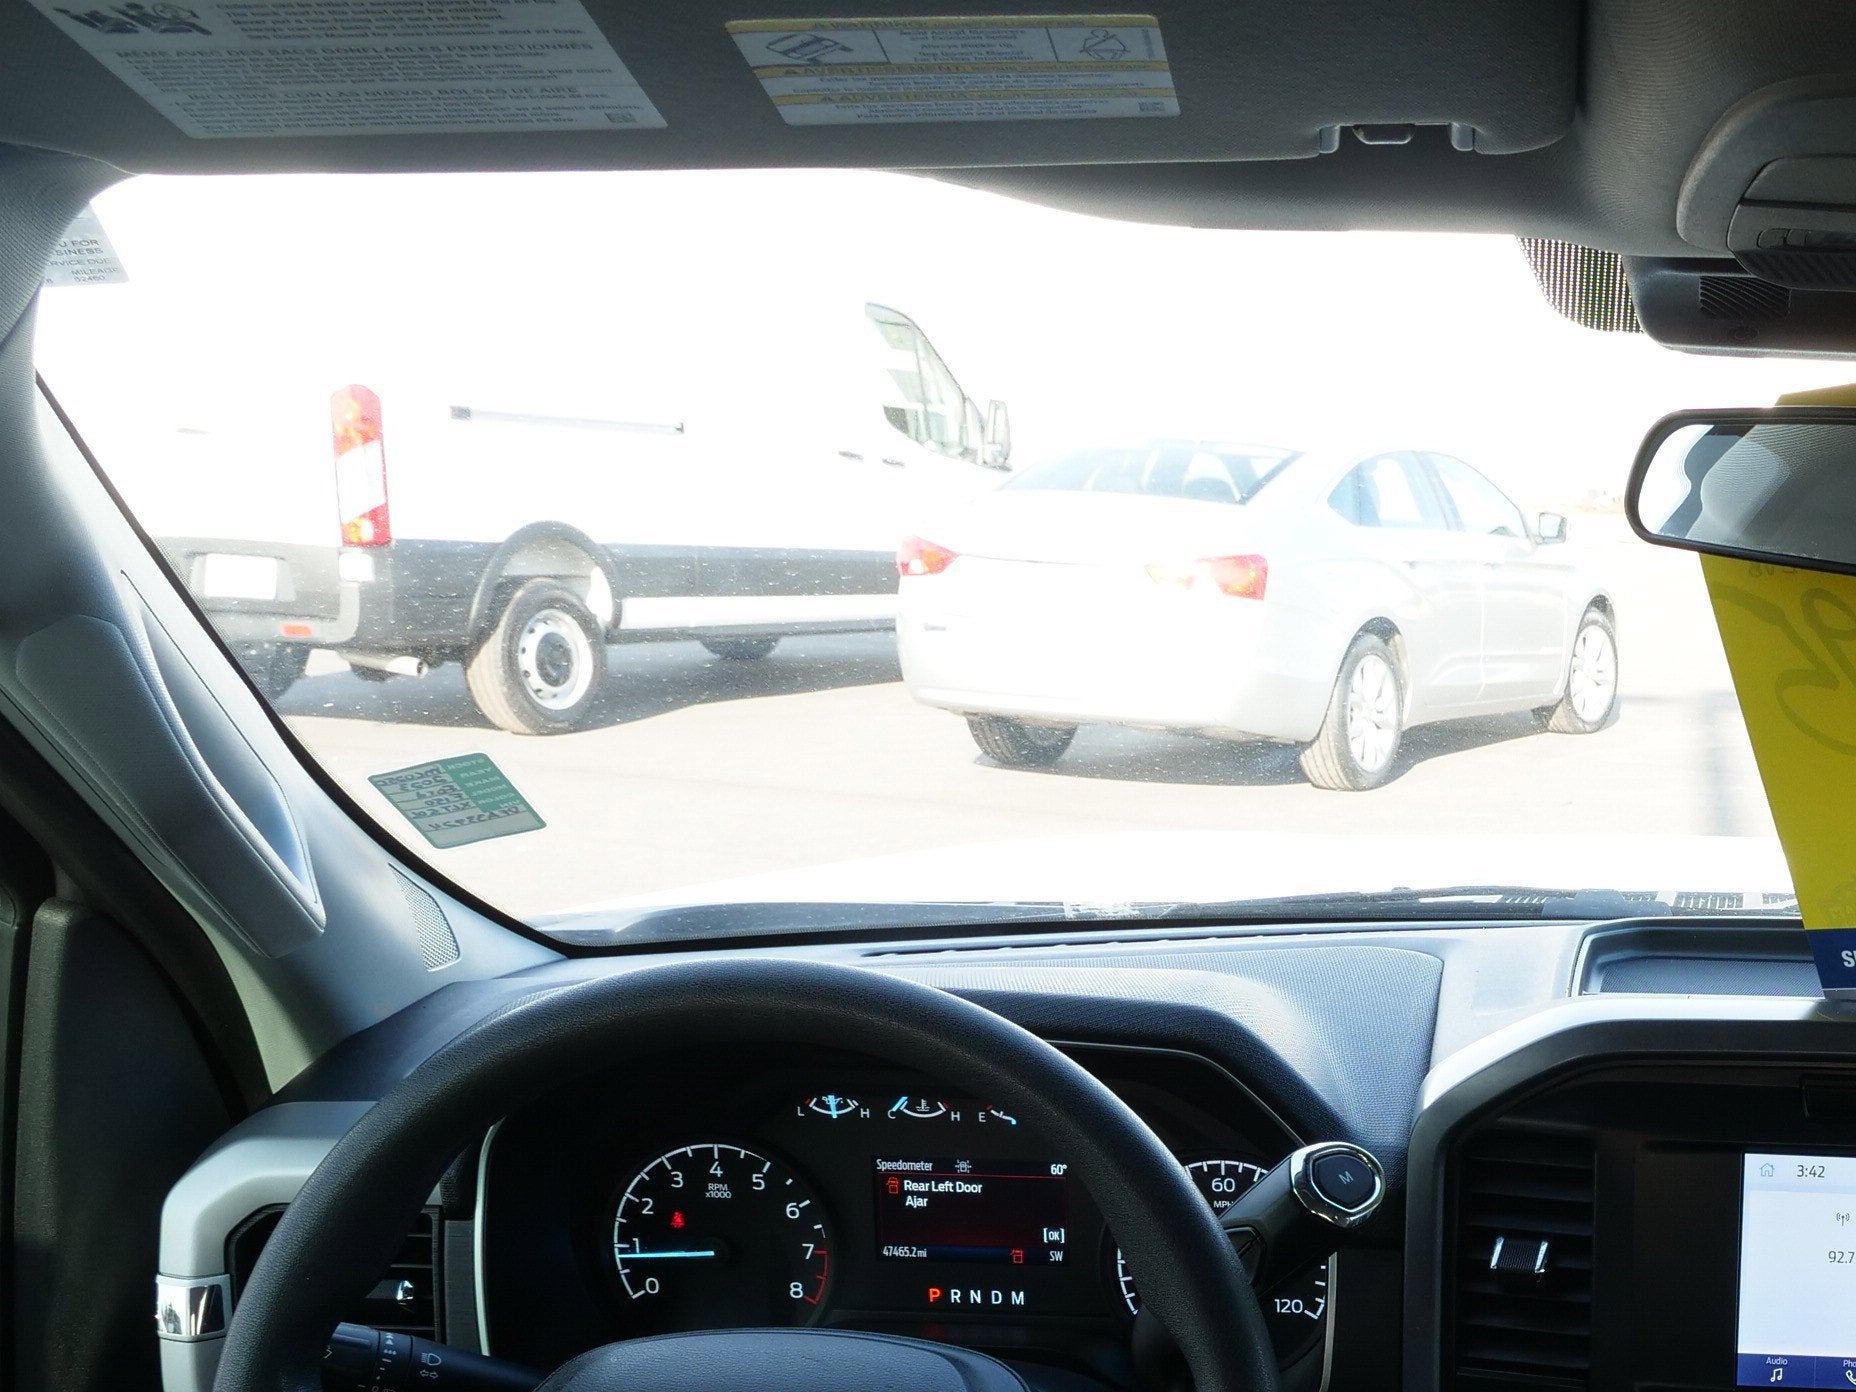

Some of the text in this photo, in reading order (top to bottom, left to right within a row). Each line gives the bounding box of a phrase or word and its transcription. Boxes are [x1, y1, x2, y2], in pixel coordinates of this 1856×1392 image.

[860, 1108, 870, 1119] H
[887, 1109, 961, 1122] C H
[978, 1111, 987, 1123] E
[709, 1161, 723, 1178] 4
[875, 1158, 1068, 1176] Speedometer 60°
[1796, 1164, 1826, 1180] 3:42
[670, 1171, 684, 1188] 3
[752, 1174, 765, 1190] 5
[1211, 1177, 1236, 1193] 60
[1338, 1170, 1354, 1185] M
[705, 1190, 732, 1199] x1000
[707, 1183, 728, 1192] RPM
[903, 1179, 983, 1194] Rear Left Door
[641, 1198, 654, 1215] 2
[905, 1195, 929, 1208] Ajar
[785, 1202, 800, 1219] 6
[632, 1237, 640, 1253] 1
[802, 1243, 815, 1260] 7
[1049, 1250, 1063, 1262] SW
[1828, 1250, 1855, 1265] 92.7
[645, 1277, 660, 1294] 0
[789, 1281, 803, 1299] 8
[929, 1288, 1025, 1305] P R N D M
[1274, 1298, 1303, 1314] 120
[1766, 1356, 1788, 1367] Audio
